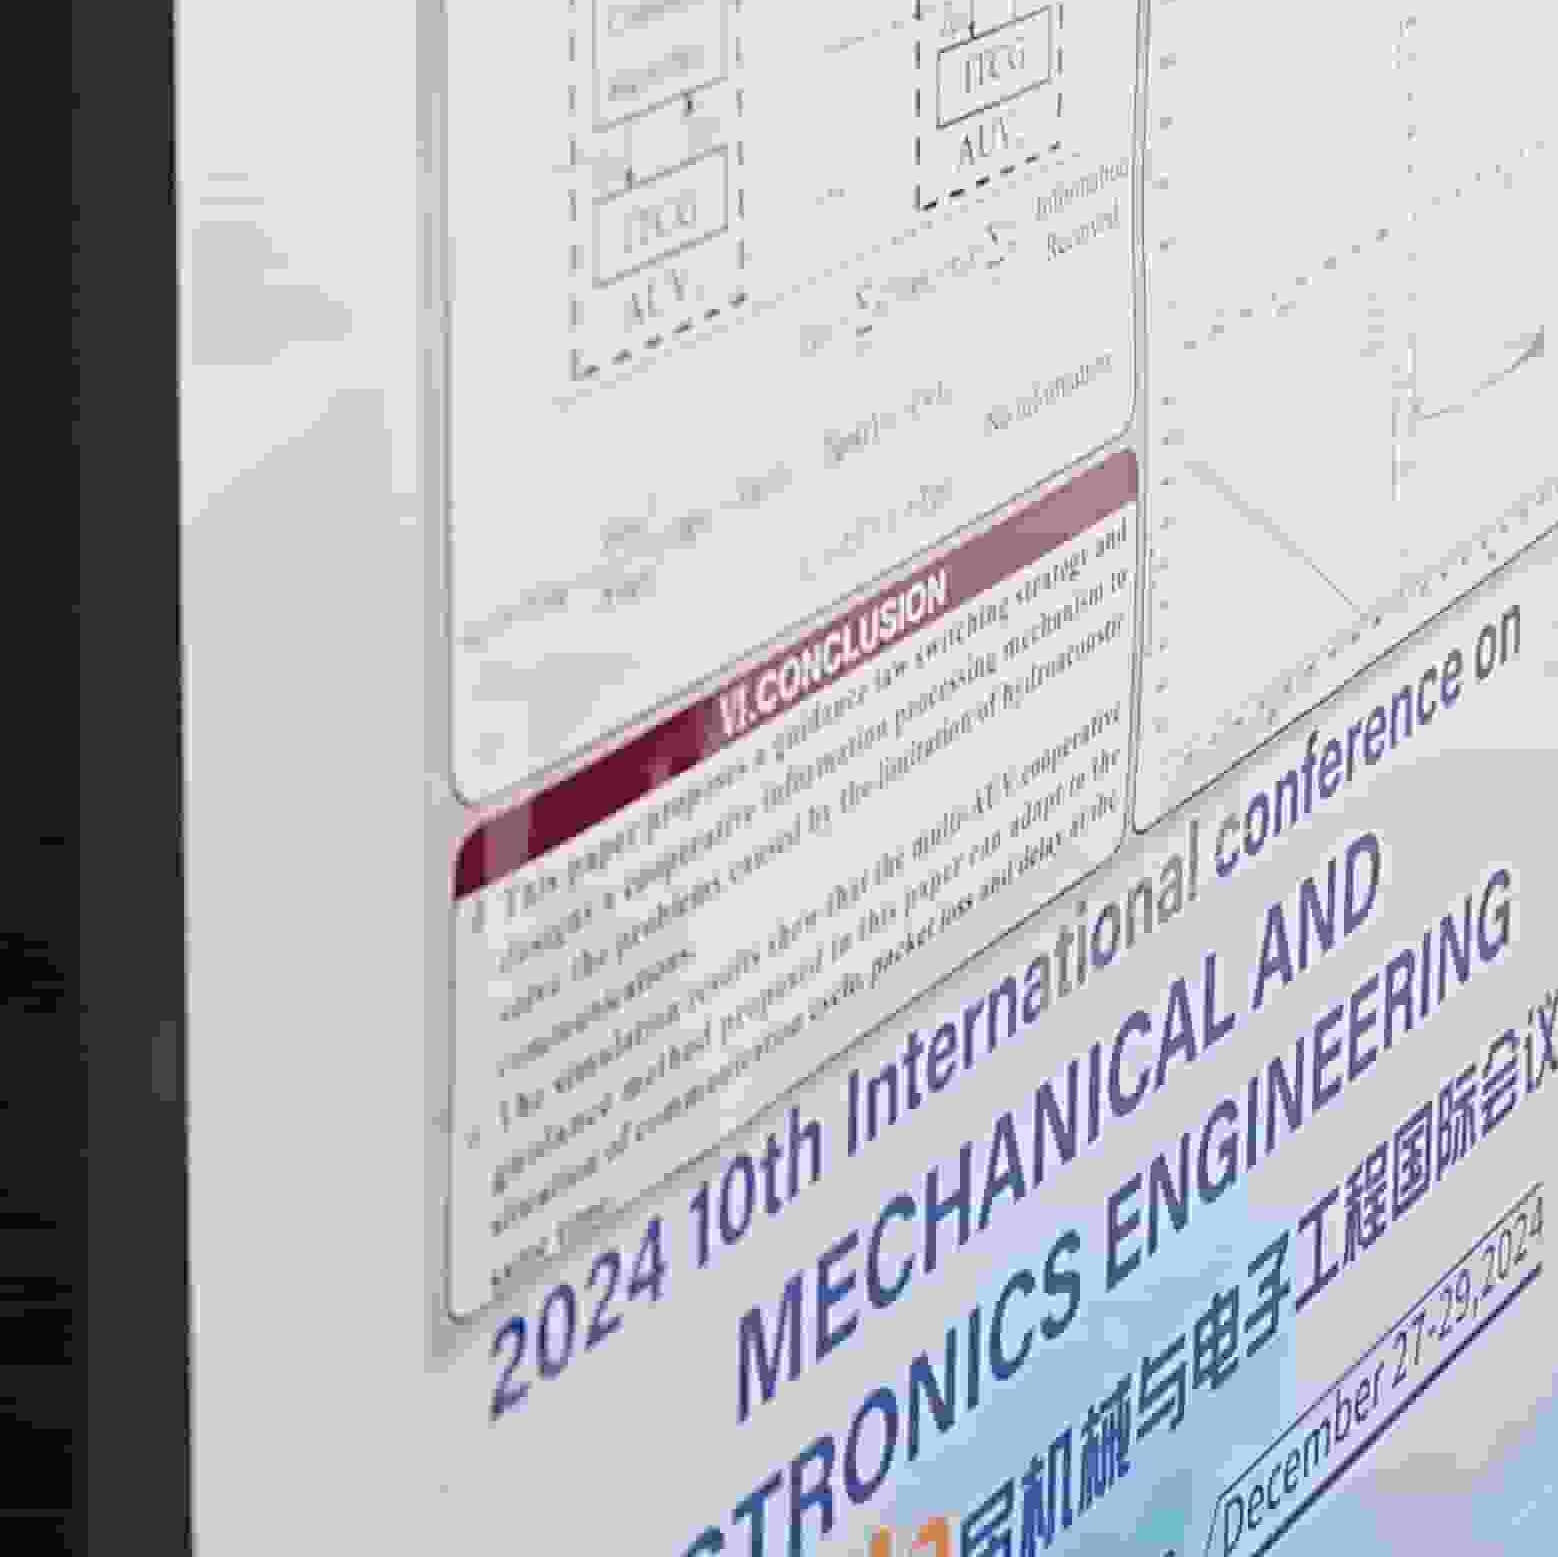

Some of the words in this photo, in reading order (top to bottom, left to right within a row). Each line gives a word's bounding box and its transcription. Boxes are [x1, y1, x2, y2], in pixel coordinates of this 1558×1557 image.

[488, 1218, 668, 1421] 2024
[688, 1116, 821, 1267] 10th
[847, 844, 1202, 1159] International
[1213, 657, 1462, 879] conference
[1473, 601, 1523, 684] on
[676, 1233, 1083, 1557] TRONICS
[1104, 866, 1513, 1289] ENGINEERING
[735, 982, 1235, 1423] MECHANICAL
[1251, 832, 1381, 1013] AND
[1221, 1350, 1385, 1553] December
[1391, 1194, 1546, 1401] 27-29,2024
